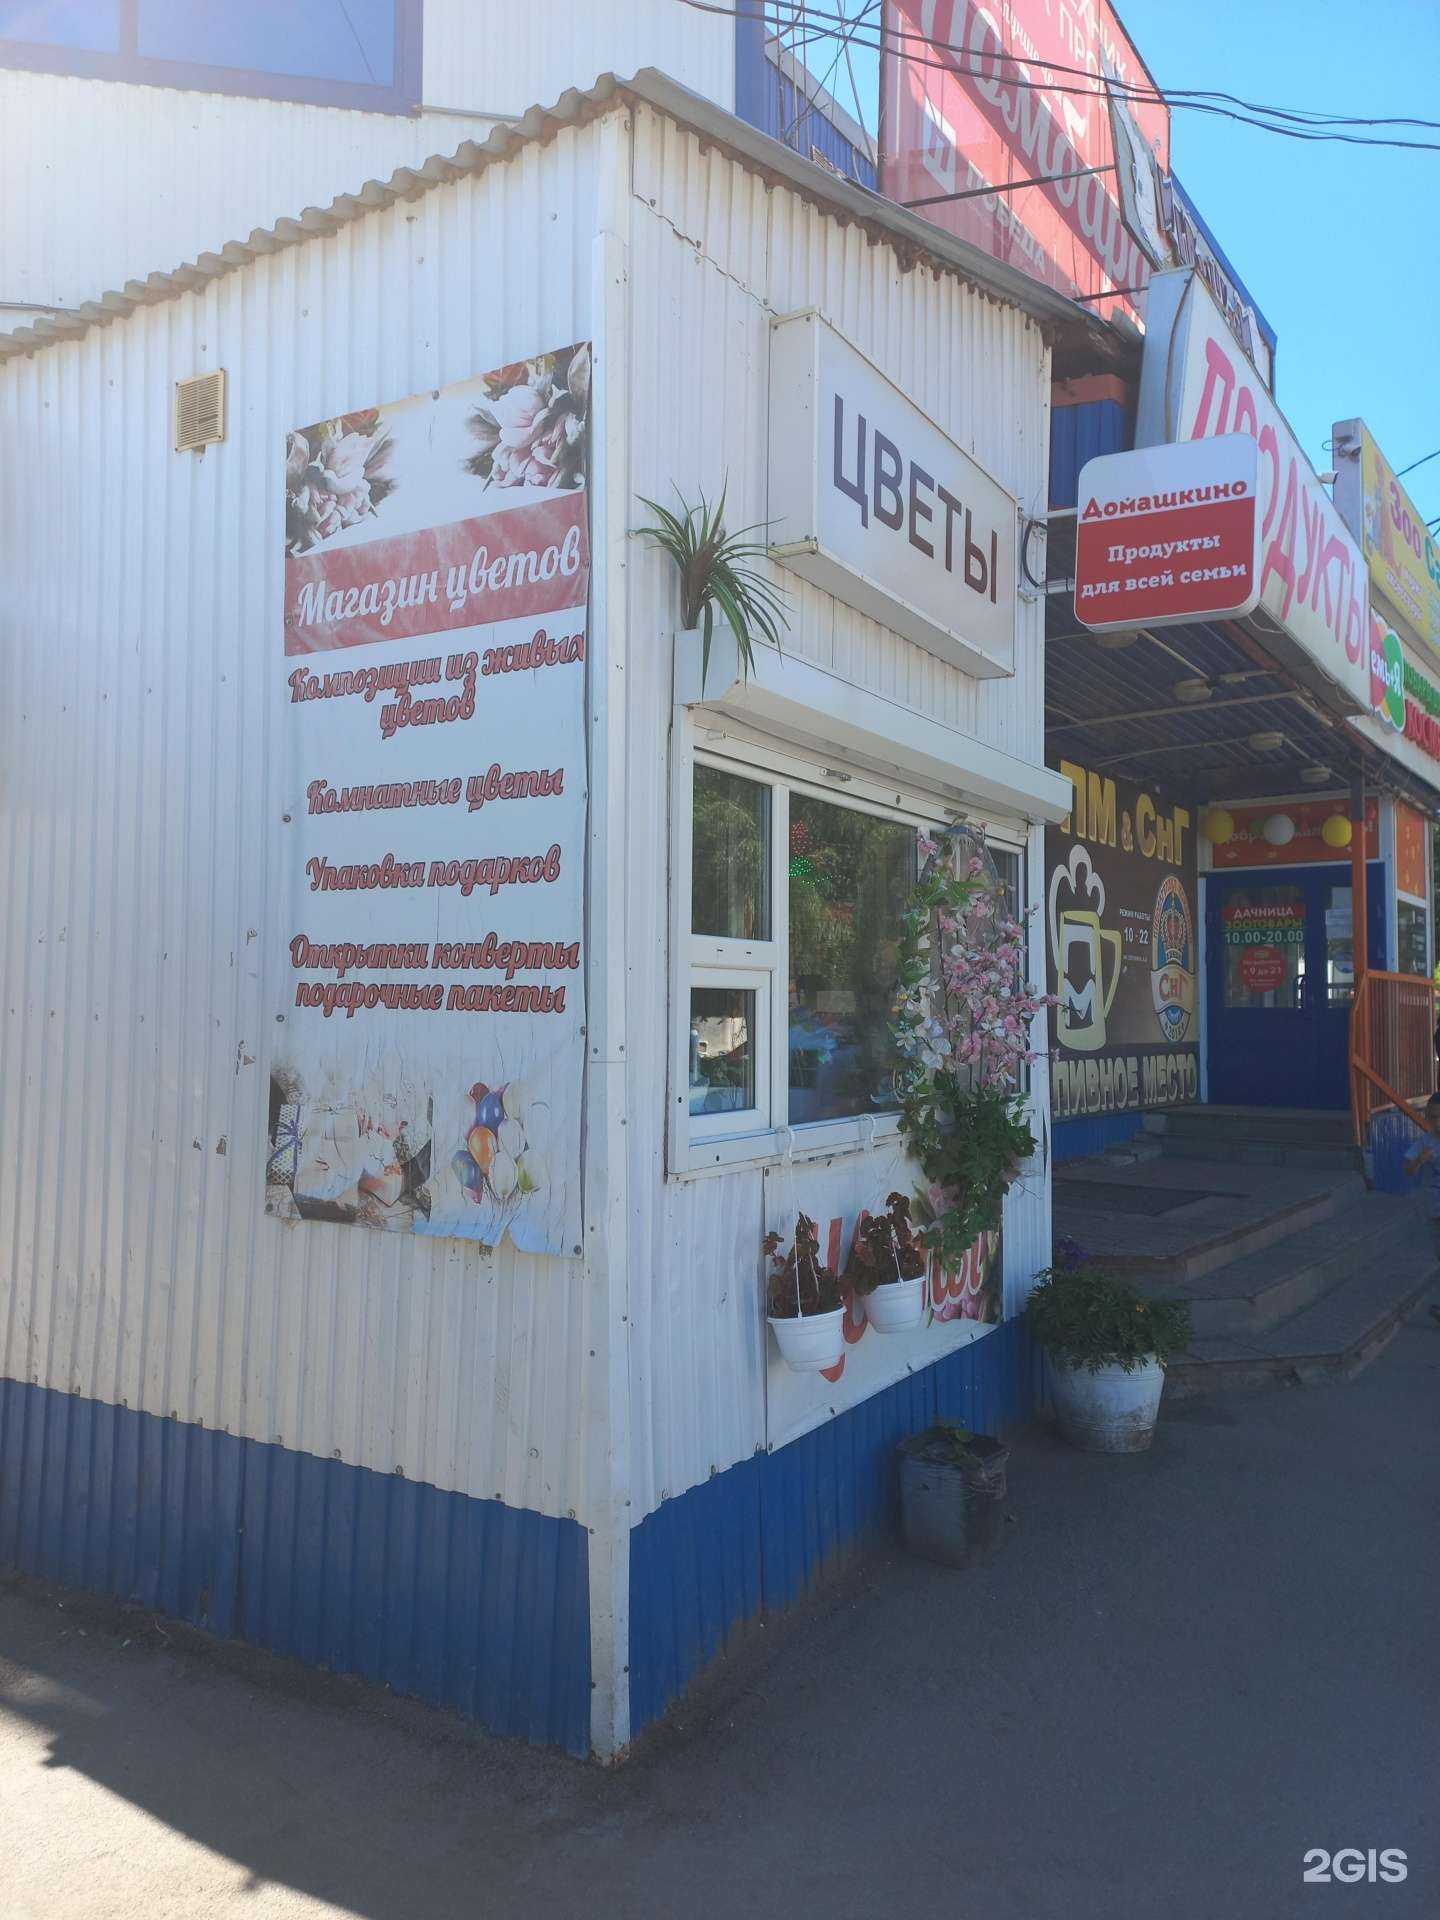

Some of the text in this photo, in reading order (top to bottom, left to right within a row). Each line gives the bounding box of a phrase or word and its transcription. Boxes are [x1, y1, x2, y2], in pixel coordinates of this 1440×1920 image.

[966, 160, 1046, 277] ПОБЕДА
[834, 393, 997, 604] ЦВЕТЫ
[1081, 479, 1248, 521] Домашкино
[1107, 534, 1221, 564] Продукты
[297, 526, 581, 627] Магазин цветов
[1081, 562, 1247, 600] для всей семьи
[288, 629, 586, 703] Композиции из живых
[379, 677, 477, 740] цветов
[306, 763, 565, 815] Комнатные цветы
[305, 844, 562, 896] Упаковка подарков
[1225, 930, 1304, 945] 10.00-20.00
[1233, 906, 1294, 919] ДАЧНИЦА
[289, 932, 580, 981] Открытки конверты
[295, 982, 566, 1018] подарочные пакеты
[1052, 1053, 1197, 1116] ПИВНОЕ МЕСТО
